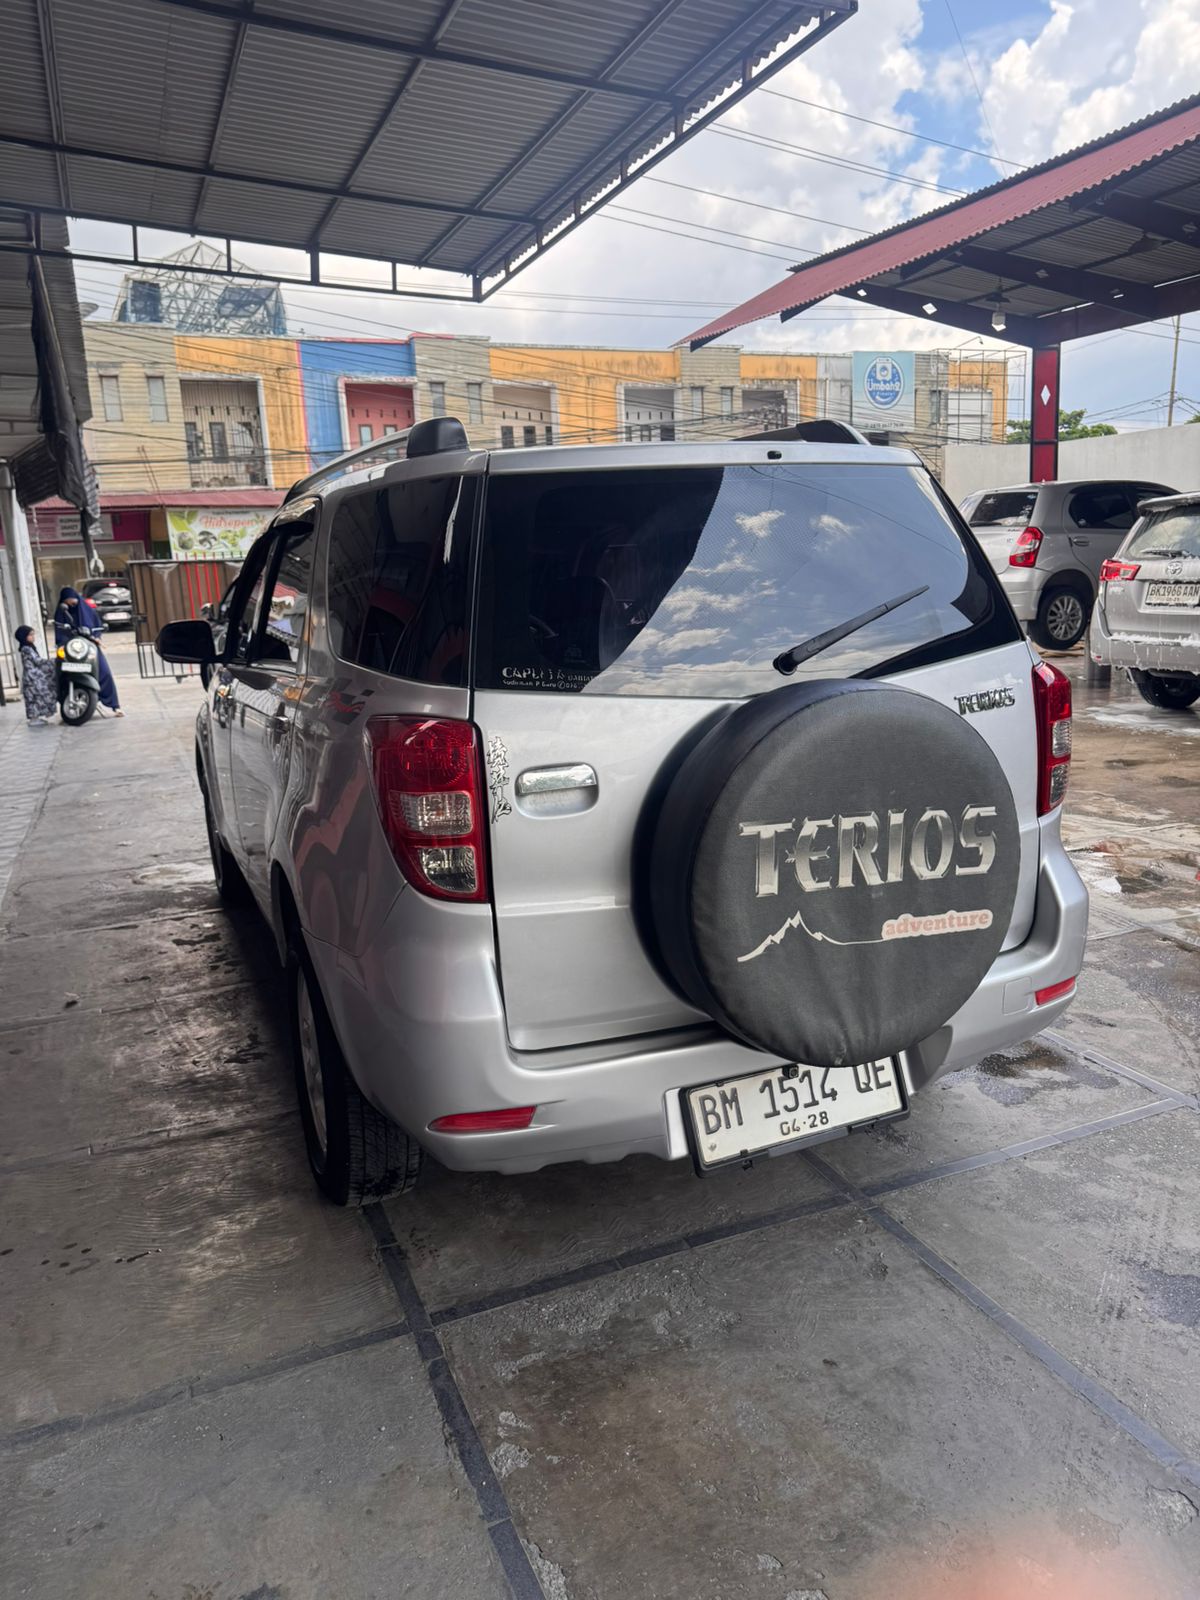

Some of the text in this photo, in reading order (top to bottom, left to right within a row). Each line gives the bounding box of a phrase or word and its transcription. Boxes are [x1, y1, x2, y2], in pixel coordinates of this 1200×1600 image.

[738, 804, 998, 898] TERIOS
[885, 911, 990, 937] adventure
[699, 1060, 892, 1136] BM 1514 QE
